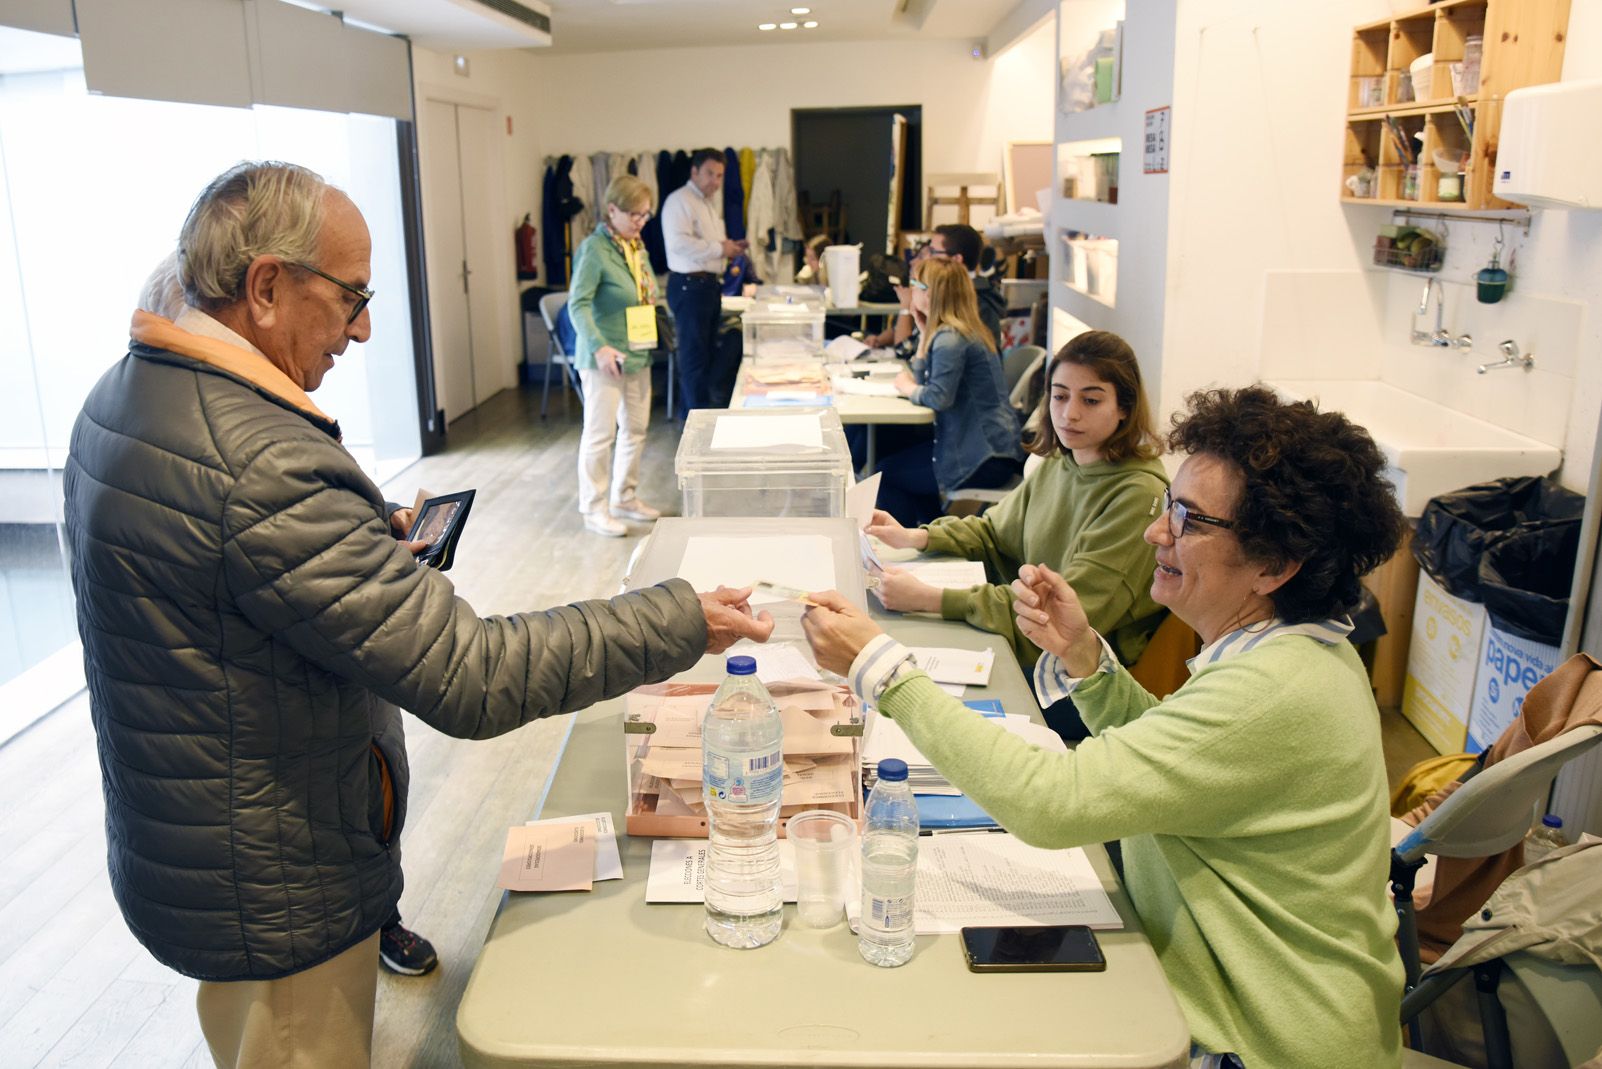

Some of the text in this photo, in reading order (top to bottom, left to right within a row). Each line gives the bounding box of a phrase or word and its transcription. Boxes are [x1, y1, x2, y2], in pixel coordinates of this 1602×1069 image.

[684, 860, 693, 884] ELECCIONES
[695, 849, 706, 890] CORTES GENERALES
